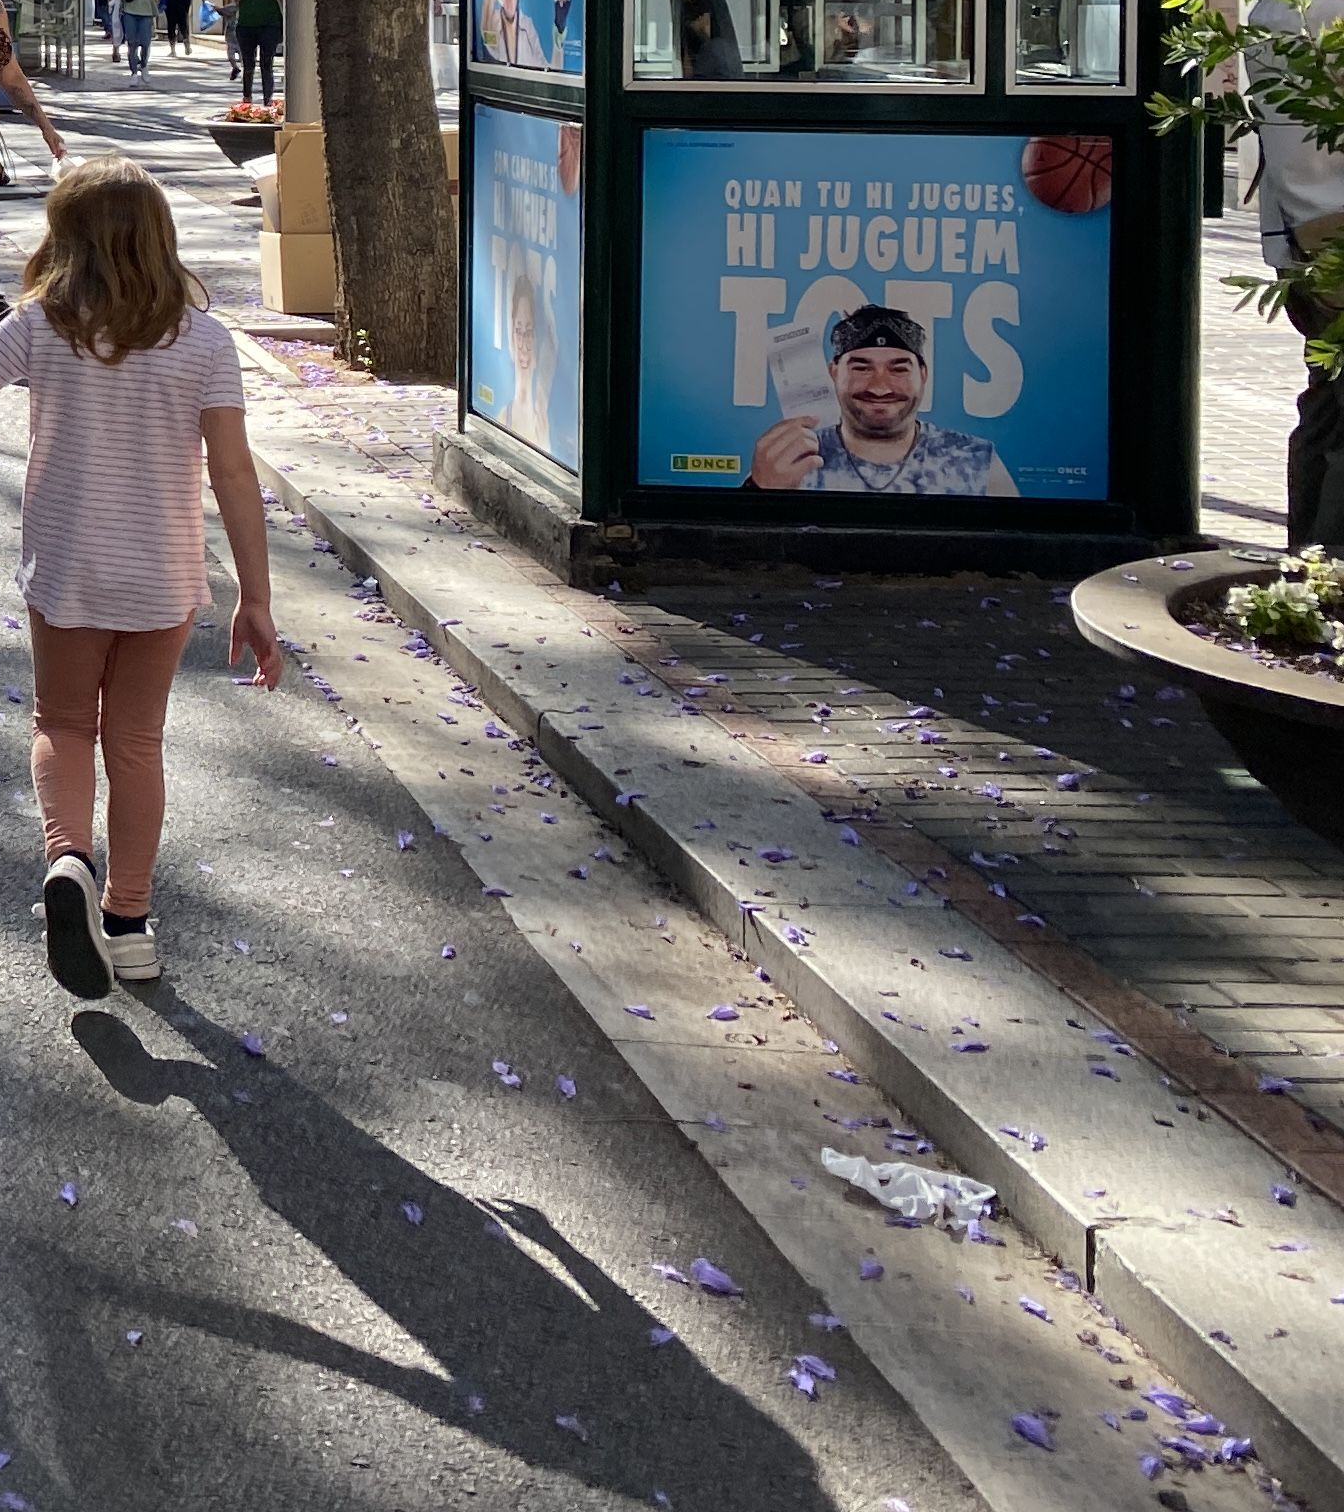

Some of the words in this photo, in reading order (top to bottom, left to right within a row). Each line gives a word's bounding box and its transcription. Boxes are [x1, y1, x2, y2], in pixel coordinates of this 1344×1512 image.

[493, 181, 506, 230] HI
[724, 179, 802, 210] QUAN
[817, 181, 851, 209] TU
[866, 182, 893, 210] HI
[907, 183, 1025, 216] JUGUES,
[726, 213, 776, 269] HI
[799, 214, 1021, 274] JUGUEM
[492, 235, 559, 351] TTS
[692, 458, 736, 470] ONCE
